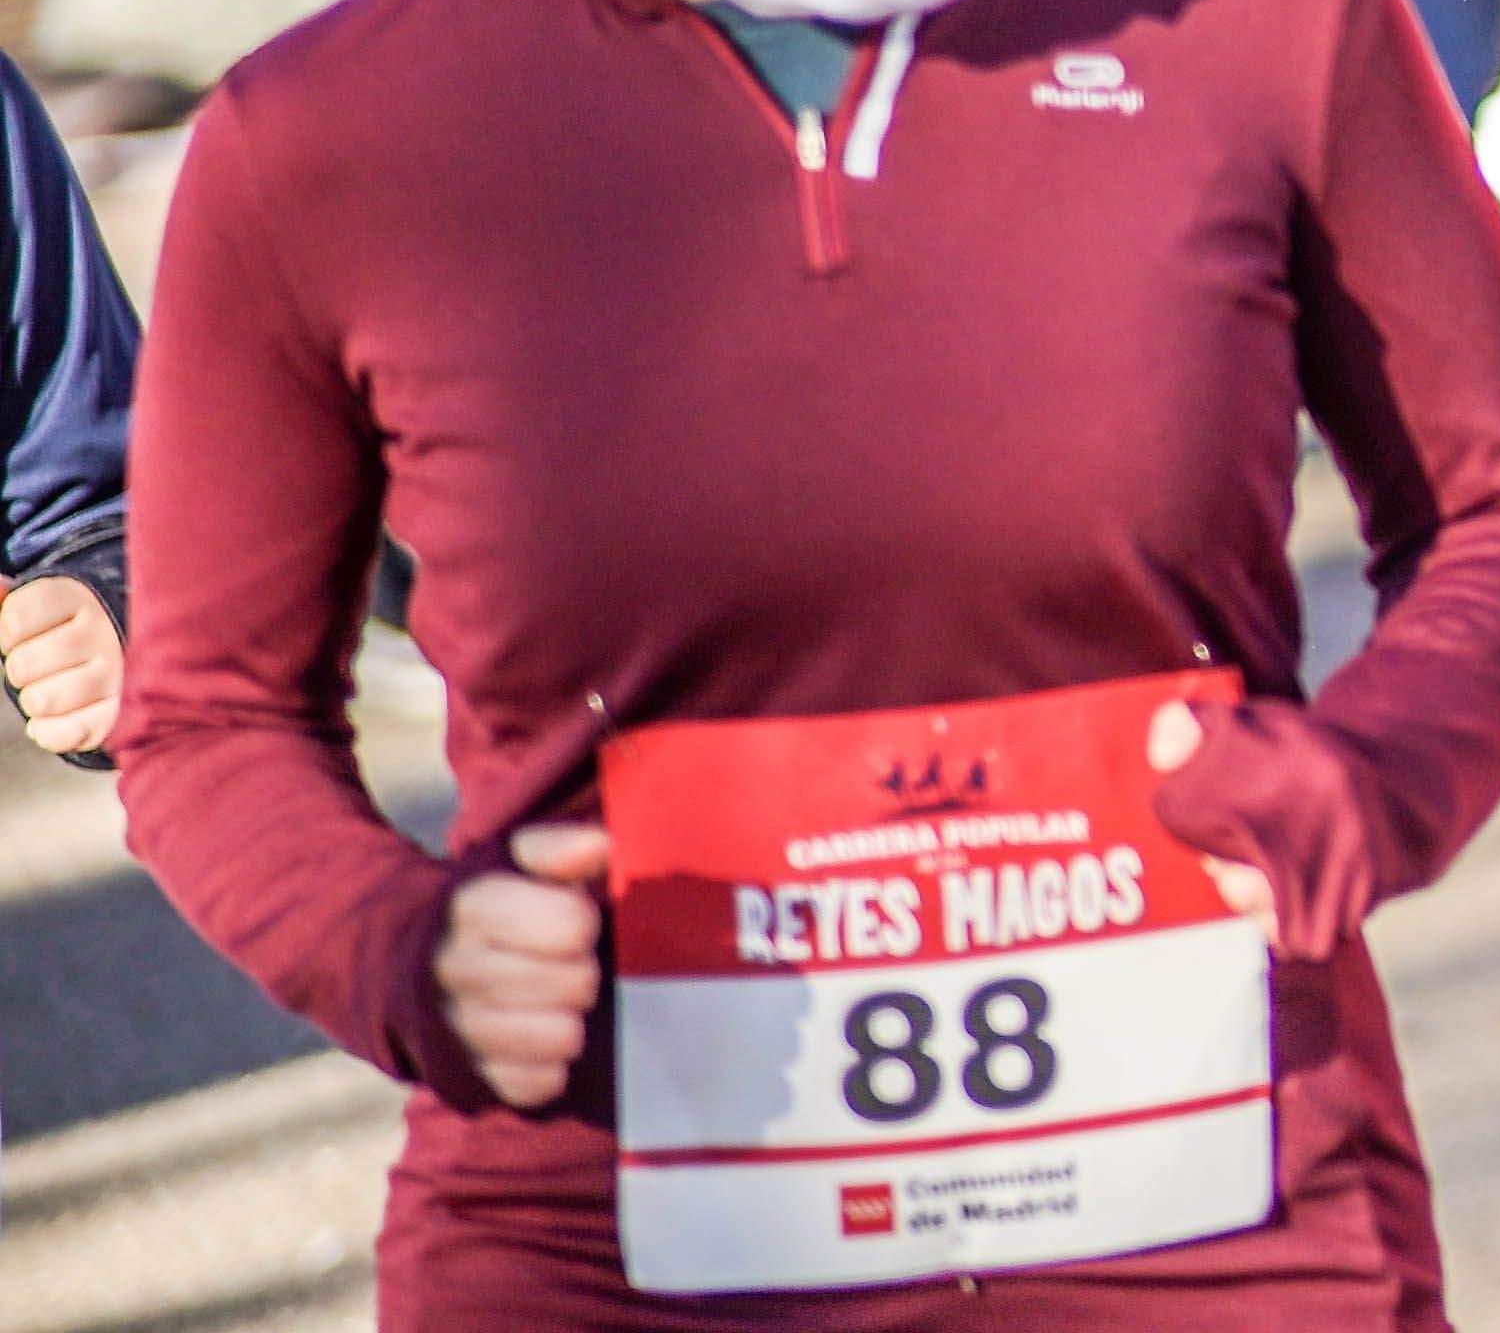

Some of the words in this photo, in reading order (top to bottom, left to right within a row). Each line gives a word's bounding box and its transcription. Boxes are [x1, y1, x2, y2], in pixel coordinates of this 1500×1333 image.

[734, 878, 921, 965] REYES
[939, 845, 1146, 953] MAGOS
[842, 977, 1057, 1123] 88
